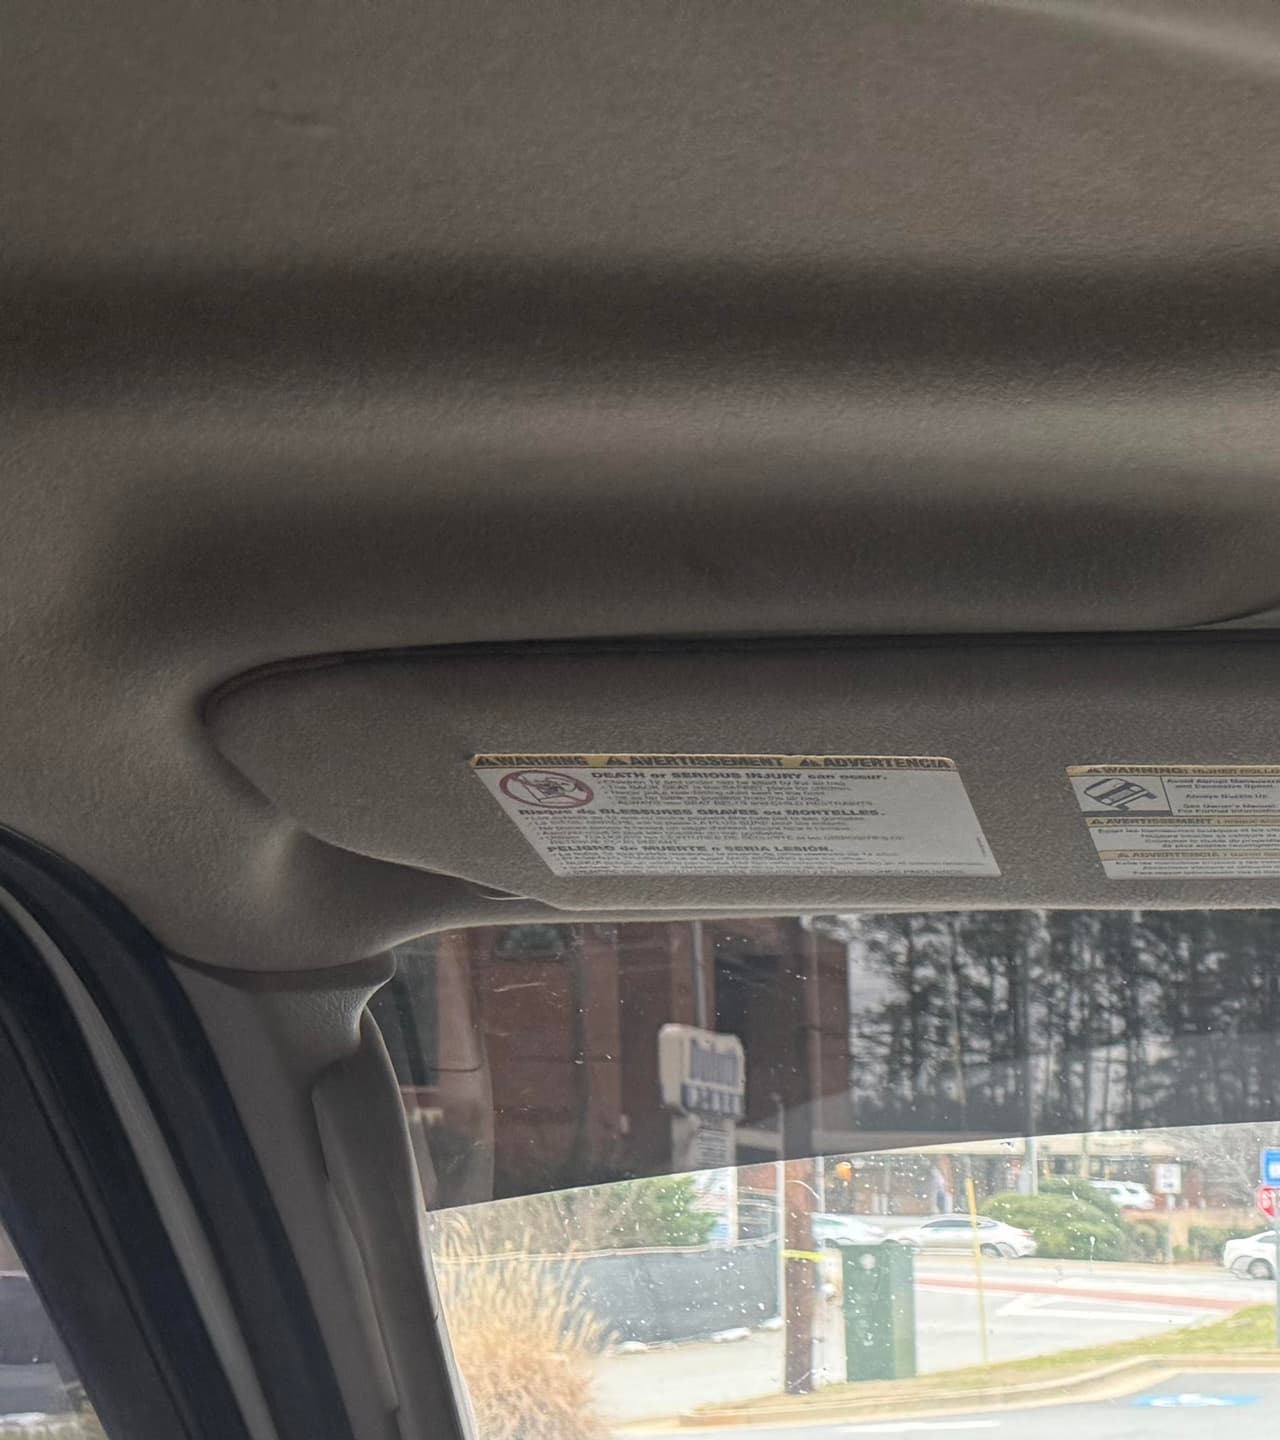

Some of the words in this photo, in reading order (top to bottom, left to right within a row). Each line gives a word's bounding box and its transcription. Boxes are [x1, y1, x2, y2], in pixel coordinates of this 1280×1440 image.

[498, 755, 588, 766] WARNING
[629, 755, 784, 767] AVERTISSEMENT
[823, 756, 951, 769] ADVERTENCIA
[745, 772, 802, 780] INJURY
